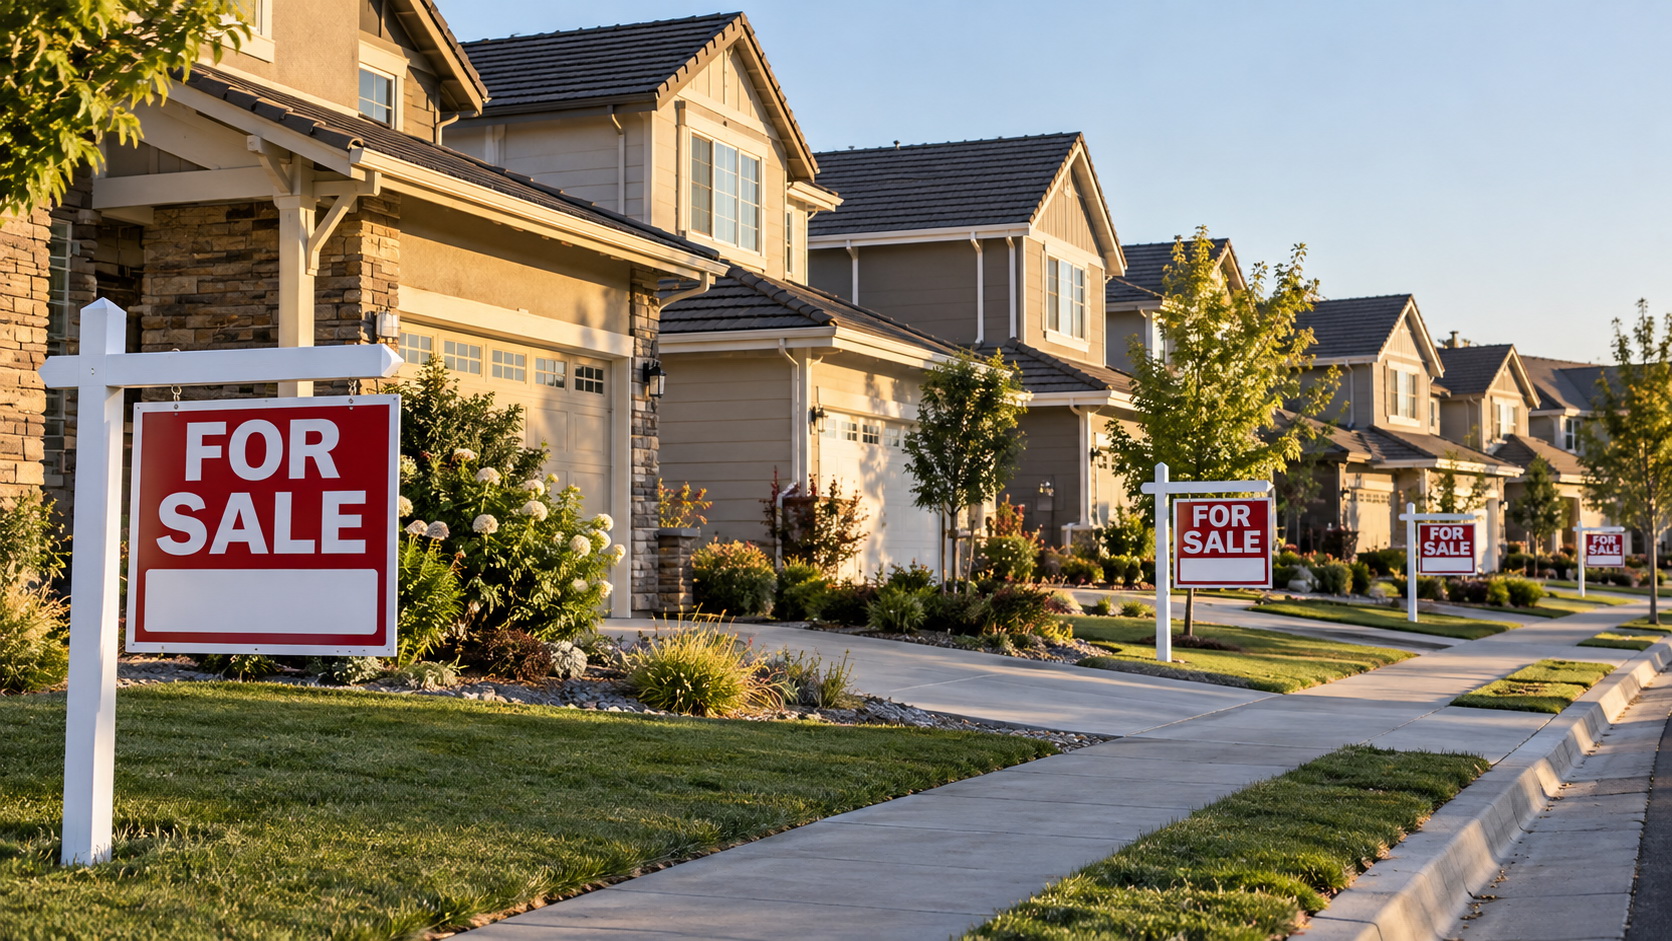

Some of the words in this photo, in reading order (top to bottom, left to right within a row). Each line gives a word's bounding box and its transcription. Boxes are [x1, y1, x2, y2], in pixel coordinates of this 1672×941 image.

[185, 418, 341, 481] FOR
[156, 490, 366, 555] SALE
[1193, 504, 1251, 528] FOR
[1183, 530, 1261, 554] SALE
[1430, 526, 1464, 540] FOR
[1592, 535, 1616, 545] FOR
[1424, 541, 1471, 556] SALE
[1589, 544, 1620, 555] SALE
